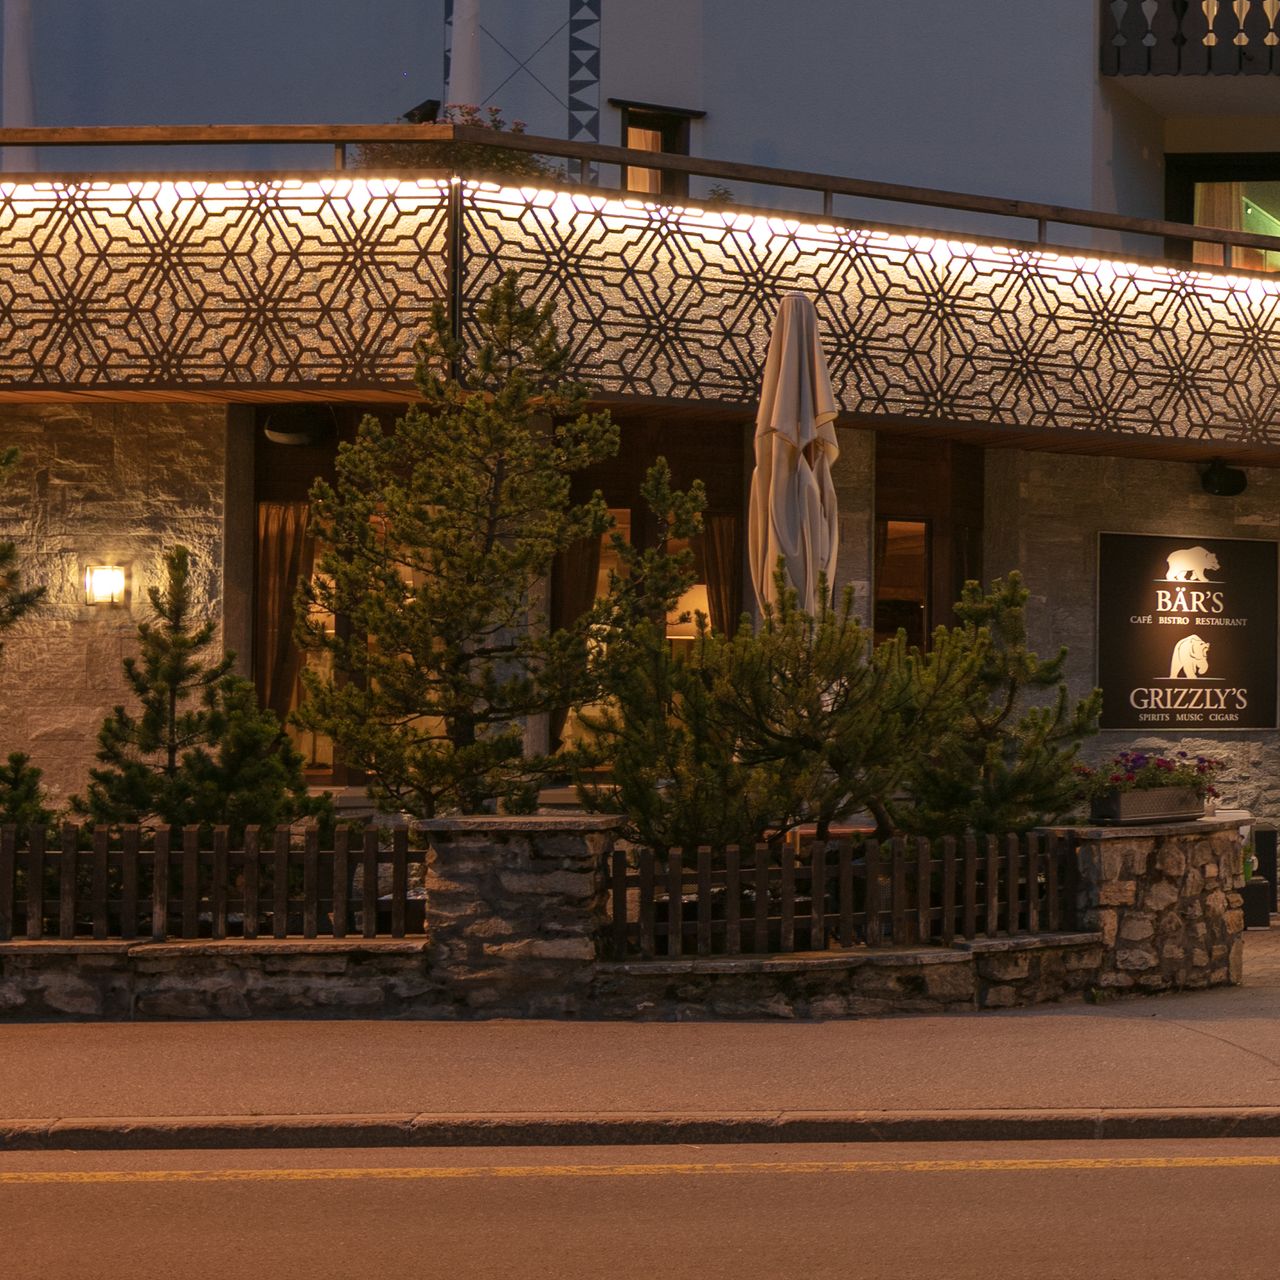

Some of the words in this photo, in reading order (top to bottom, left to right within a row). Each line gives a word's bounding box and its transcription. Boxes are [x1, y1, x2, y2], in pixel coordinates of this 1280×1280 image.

[1156, 586, 1224, 613] BÄR'S
[1130, 615, 1153, 624] CAFÉ
[1159, 616, 1190, 625] BISTRO
[1195, 617, 1248, 626] RESTAURANT
[1129, 688, 1248, 710] GRIZZLY'S
[1138, 713, 1170, 721] SPIRITS
[1176, 713, 1203, 721] MUSIC
[1209, 713, 1239, 721] CIGARS
